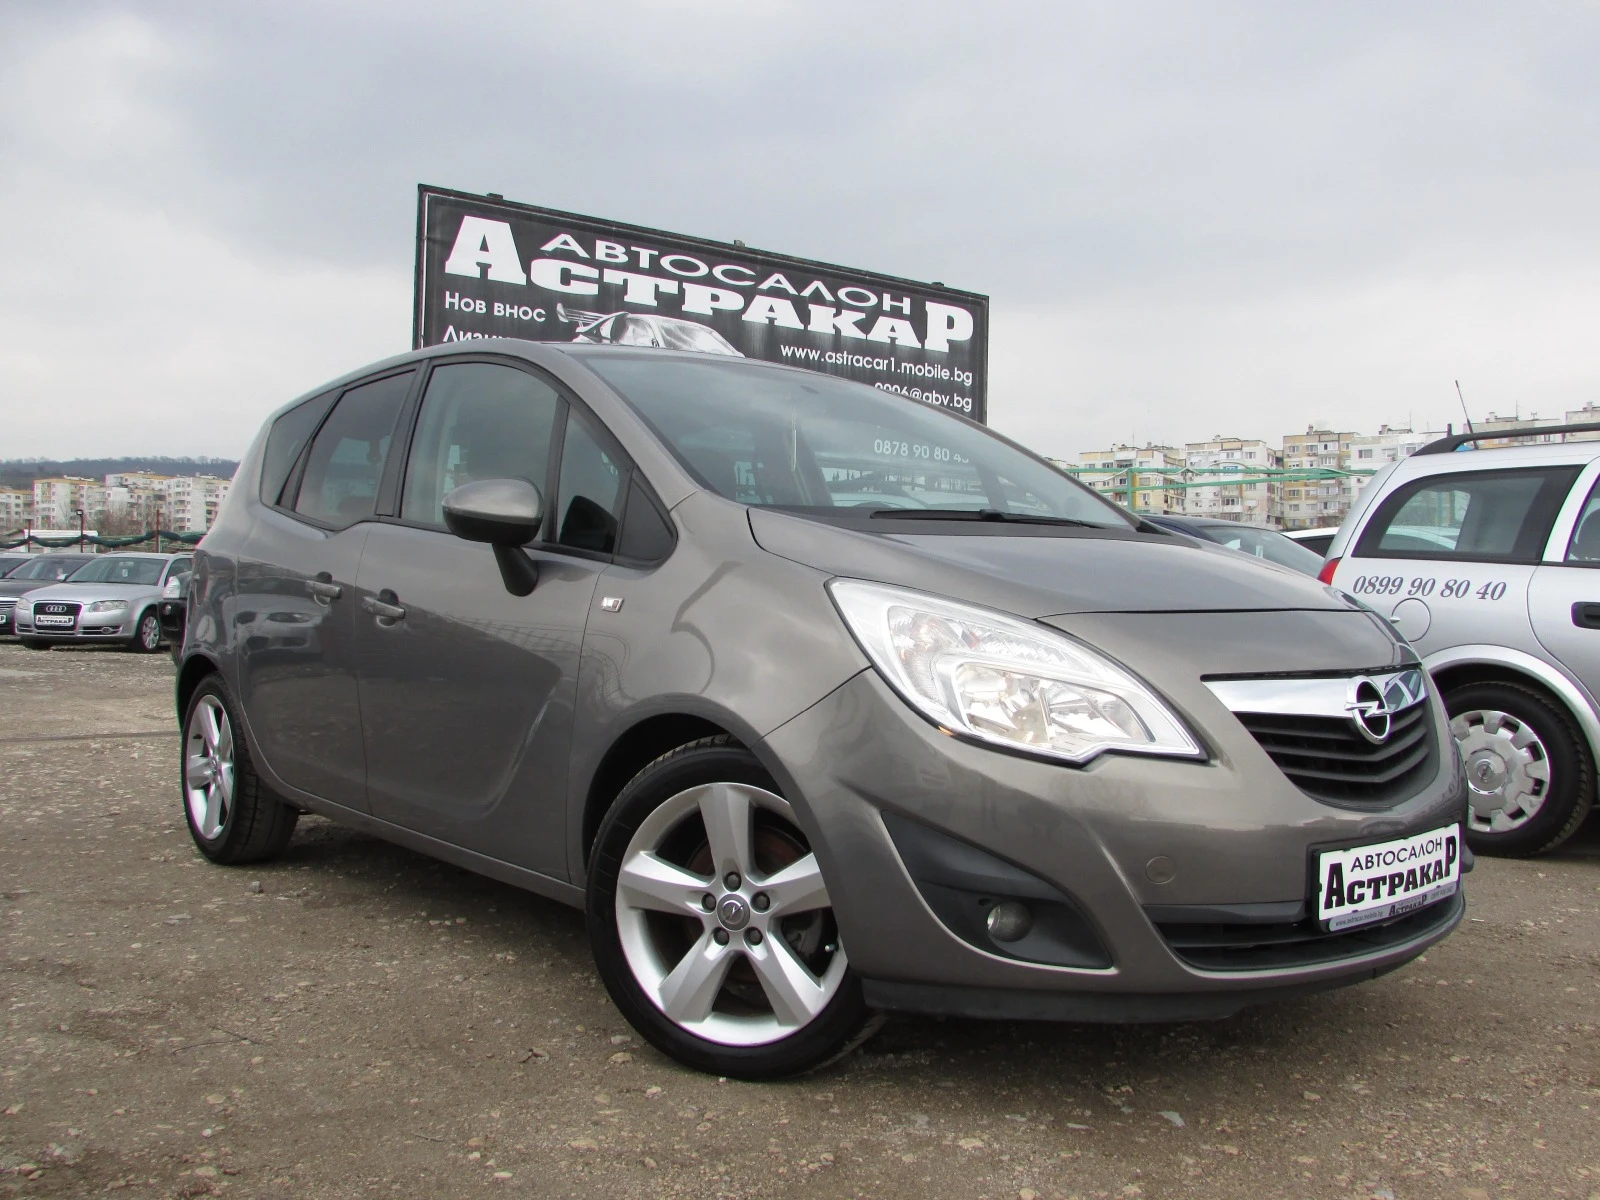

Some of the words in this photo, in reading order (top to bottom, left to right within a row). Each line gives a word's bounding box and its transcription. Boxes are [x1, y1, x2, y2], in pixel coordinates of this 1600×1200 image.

[540, 233, 911, 315] АВТОСАЛОН
[444, 291, 487, 314] Нов
[493, 302, 546, 322] внос
[780, 343, 973, 386] www.astracar1.mobile.bg
[874, 438, 909, 457] 0878
[912, 444, 930, 459] 90
[933, 446, 950, 462] 80
[1352, 575, 1403, 596] 0899
[1407, 577, 1436, 597] 90
[1439, 578, 1471, 599] 80
[1475, 581, 1507, 601] 40
[1350, 836, 1443, 873] АВТОСАЛОН
